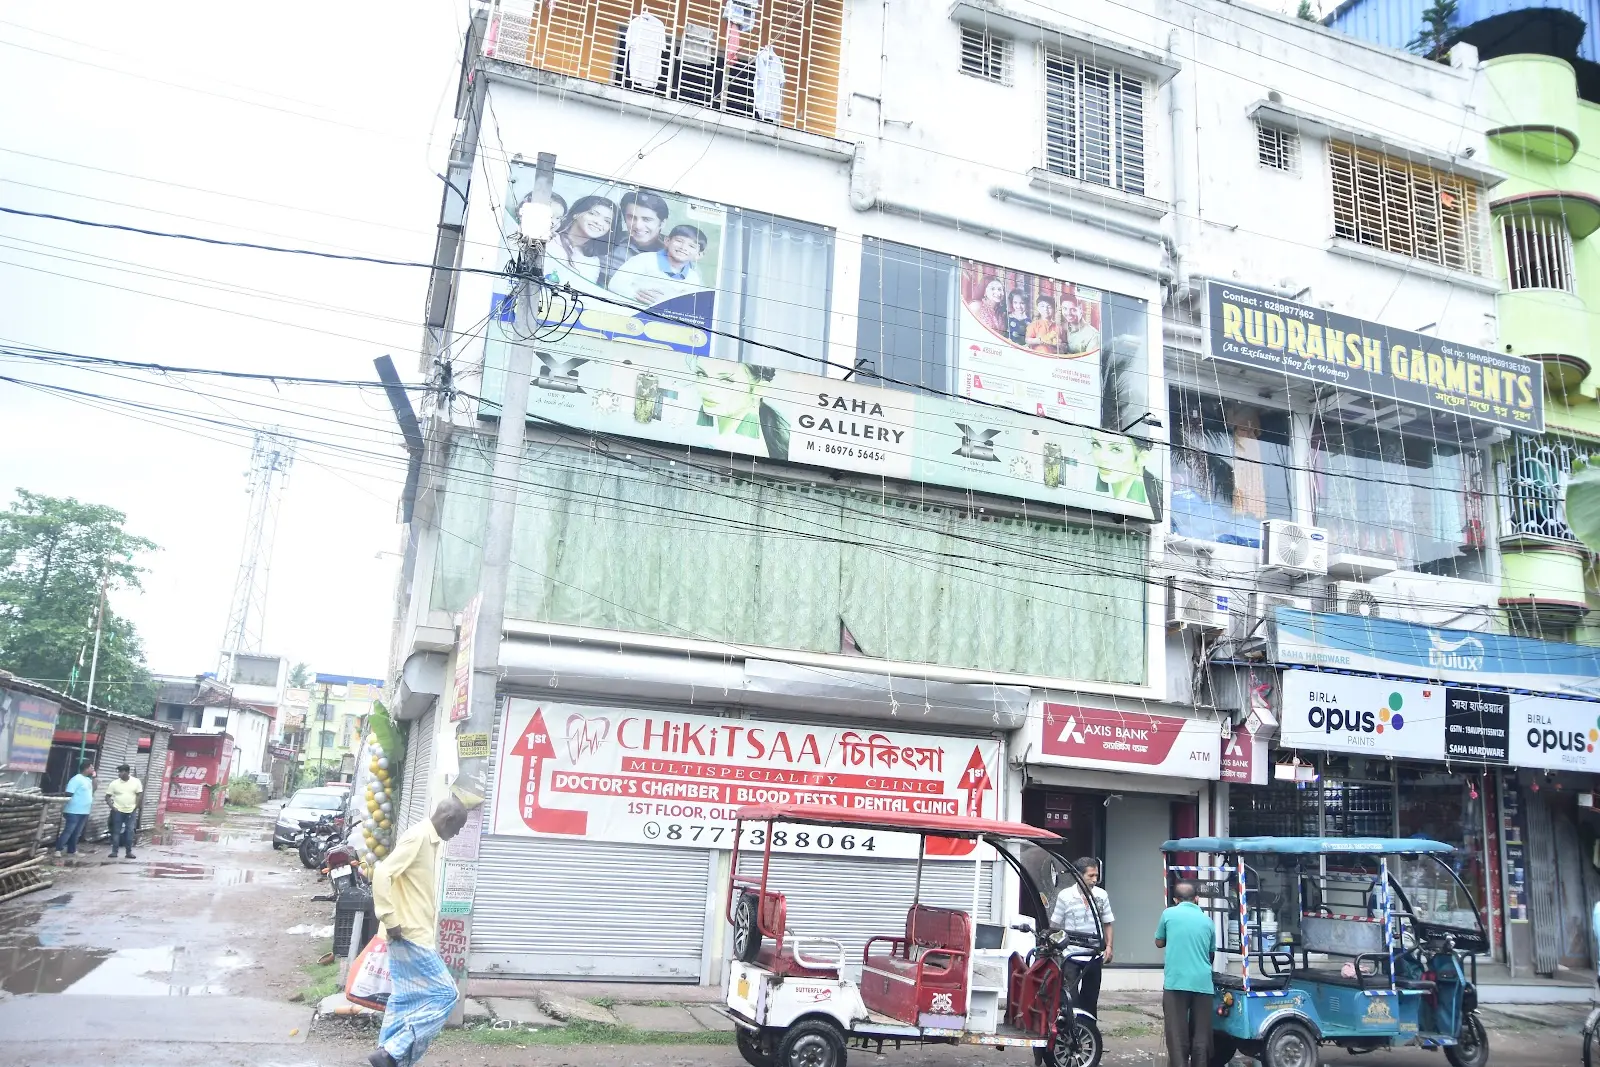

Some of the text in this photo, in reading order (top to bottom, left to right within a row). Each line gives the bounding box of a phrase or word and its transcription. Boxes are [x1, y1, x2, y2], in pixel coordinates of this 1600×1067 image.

[1222, 290, 1257, 305] Contact
[1265, 301, 1314, 320] 6289877462
[1222, 302, 1534, 410] RUDRANSH GARMENTS
[1222, 341, 1350, 380] (An Exclusive Shop for Women)
[1441, 345, 1453, 354] Gst
[1454, 350, 1465, 358] no:
[818, 392, 884, 417] SAHA
[798, 414, 905, 444] GALLERY
[806, 440, 815, 450] M
[825, 443, 854, 457] 86976
[857, 449, 886, 461] 56454
[1281, 649, 1351, 665] SAHA HARDWARE
[1428, 647, 1479, 671] Dulux
[1309, 691, 1338, 704] BIRLA
[1451, 699, 1468, 711] সাহা
[1308, 706, 1375, 734] opus
[1527, 713, 1552, 725] BIRLA
[526, 732, 547, 750] 1st
[1084, 724, 1149, 740] AXIS BANK
[1347, 735, 1375, 747] PAINTS
[1526, 727, 1586, 754] opus
[839, 731, 945, 773] চিকিৎসা
[1189, 750, 1211, 763] ATM
[1449, 744, 1505, 758] SAHA HARDWARE
[1561, 754, 1587, 765] PAINTS
[1232, 760, 1249, 768] BANK
[630, 759, 938, 792] MULTISPECIALITY CLINIC
[967, 767, 985, 784] 1st
[523, 755, 538, 820] FLOOR
[555, 774, 637, 793] DOCTOR'S
[641, 779, 719, 801] CHAMBER
[737, 788, 790, 806] BLOOD
[793, 791, 838, 807] TESTS
[854, 797, 910, 813] DENTAL
[913, 800, 956, 816] CLINIC
[628, 801, 653, 815] 1ST
[655, 804, 707, 821] FLOOR,
[709, 807, 738, 821] OLD
[666, 823, 877, 852] 8777388064
[795, 986, 823, 994] BUTTERFLY
